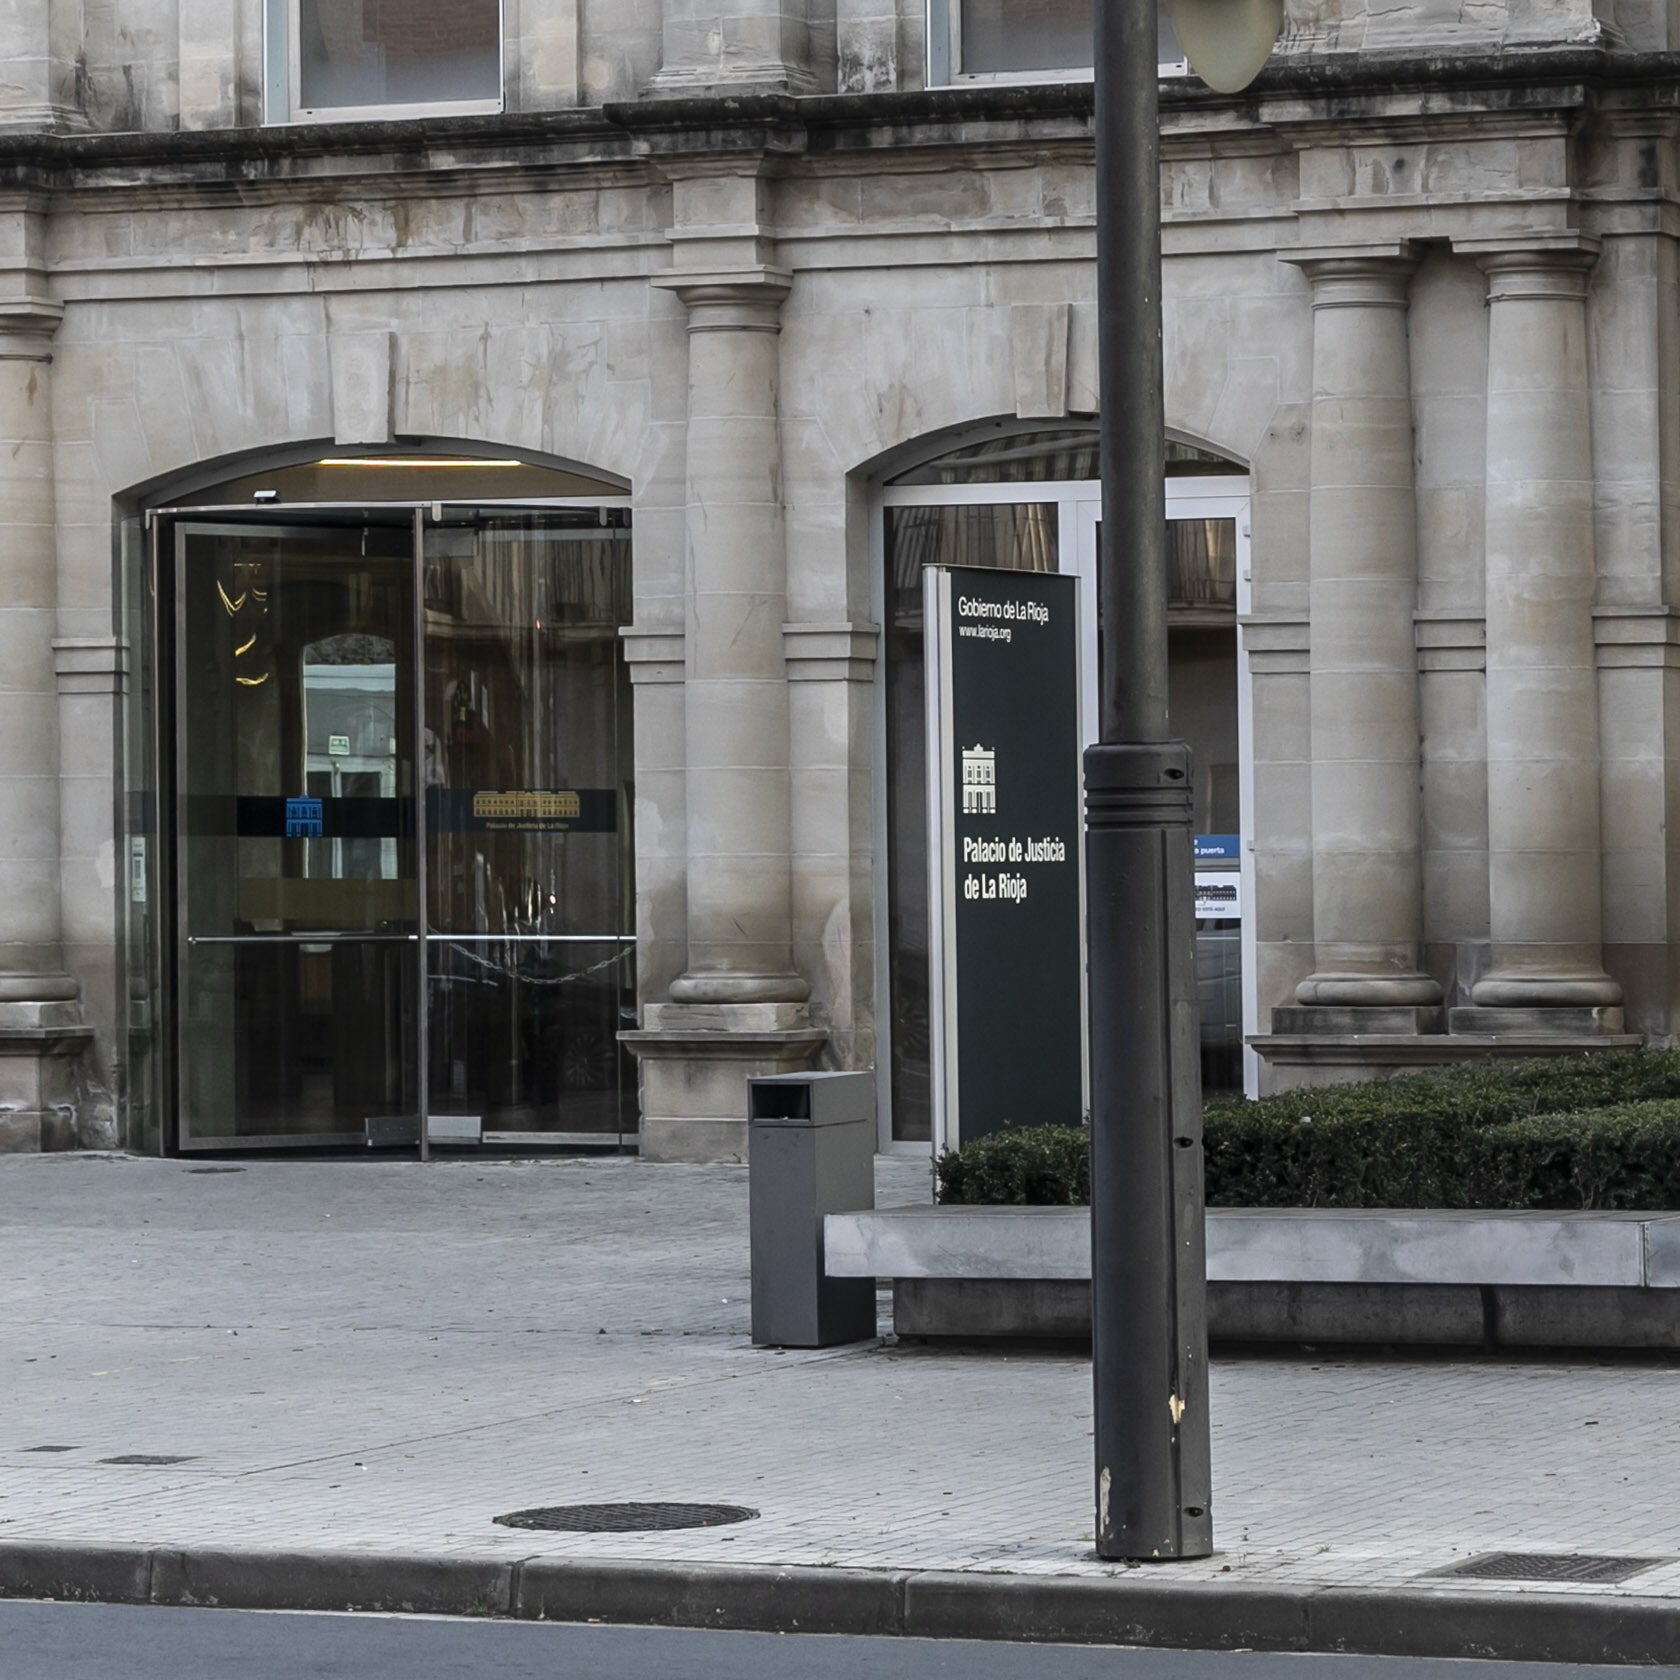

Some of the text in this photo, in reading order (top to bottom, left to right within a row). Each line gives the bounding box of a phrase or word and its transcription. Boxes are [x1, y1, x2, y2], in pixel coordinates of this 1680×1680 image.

[958, 595, 1049, 626] Gobierno de La Rioja
[958, 624, 1012, 643] www.larioja.org
[963, 836, 1065, 862] Palacio de Justicia
[964, 872, 1027, 904] de La Rioja
